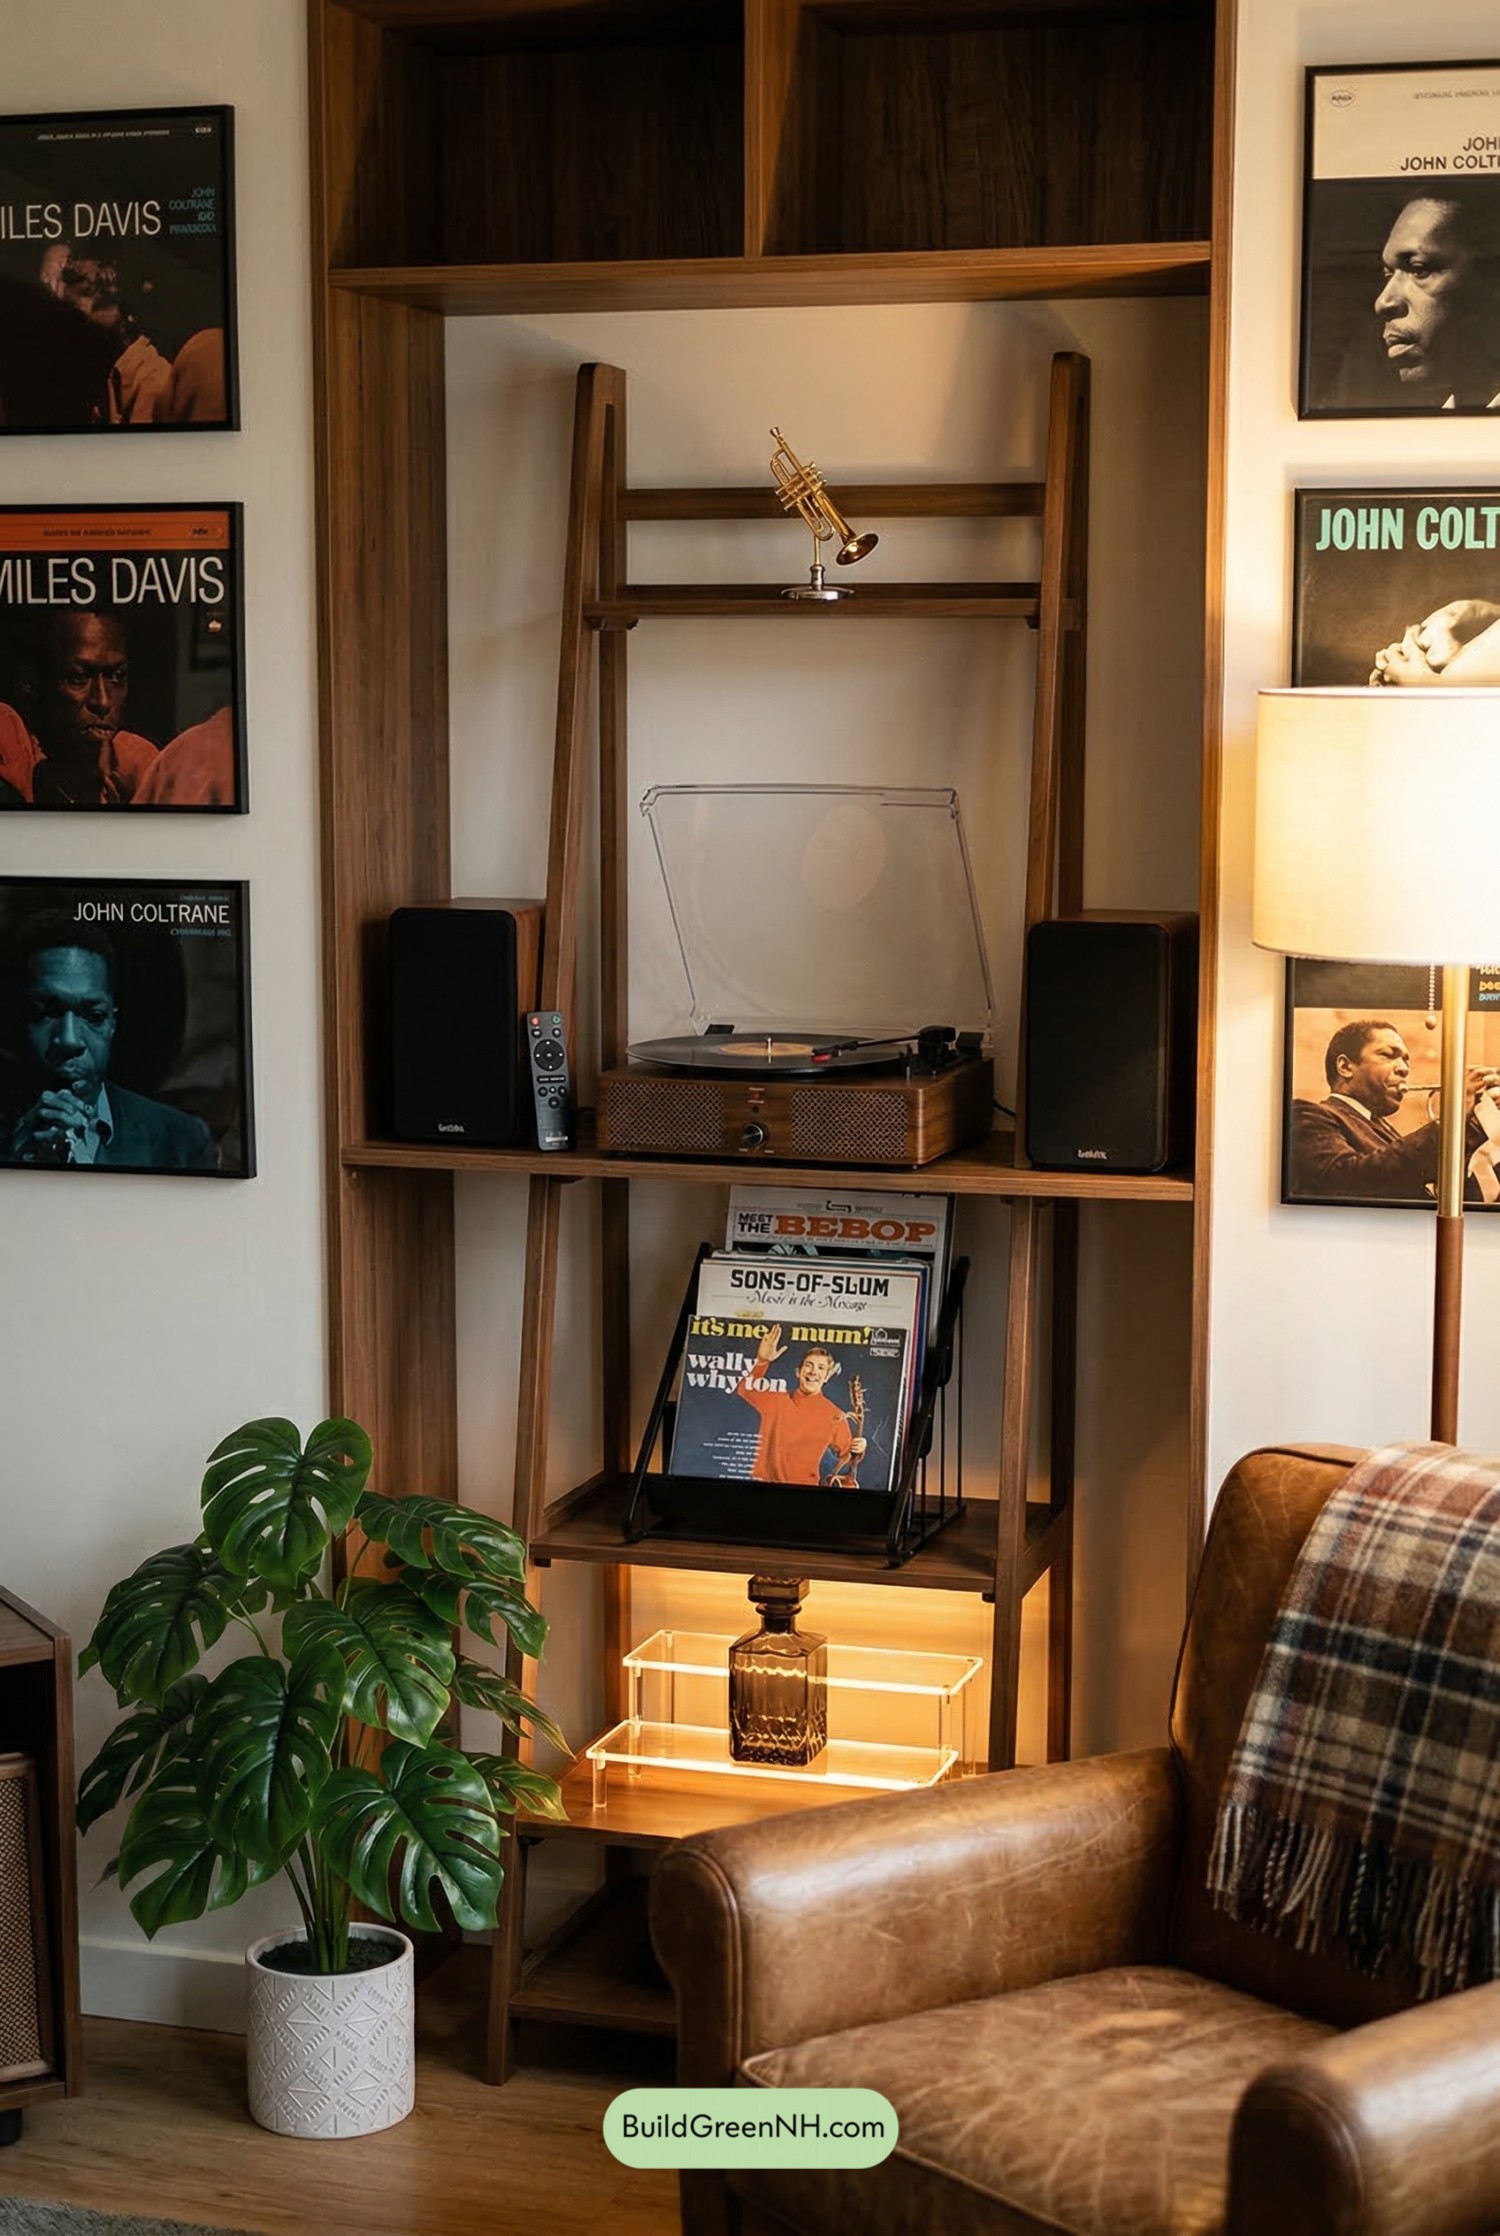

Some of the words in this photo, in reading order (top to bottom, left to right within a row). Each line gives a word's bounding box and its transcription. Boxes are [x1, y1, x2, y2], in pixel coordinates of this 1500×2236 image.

[1462, 136, 1500, 151] JOH
[1400, 156, 1447, 171] JOHN
[1453, 155, 1500, 169] COLT
[74, 200, 161, 237] DAVIS
[1316, 508, 1404, 551] JOHN
[1416, 506, 1500, 550] COLT
[111, 556, 225, 604] DAVIS
[73, 902, 124, 922] JOHN
[130, 903, 230, 924] COLTRANE
[738, 1213, 774, 1223] MEET
[738, 1222, 771, 1234] THE
[774, 1215, 936, 1243] BEBOP
[730, 1269, 890, 1297] SONS-OF-SLUM
[691, 1316, 725, 1337] it's
[790, 1325, 871, 1345] mum!
[687, 1351, 759, 1378] wally
